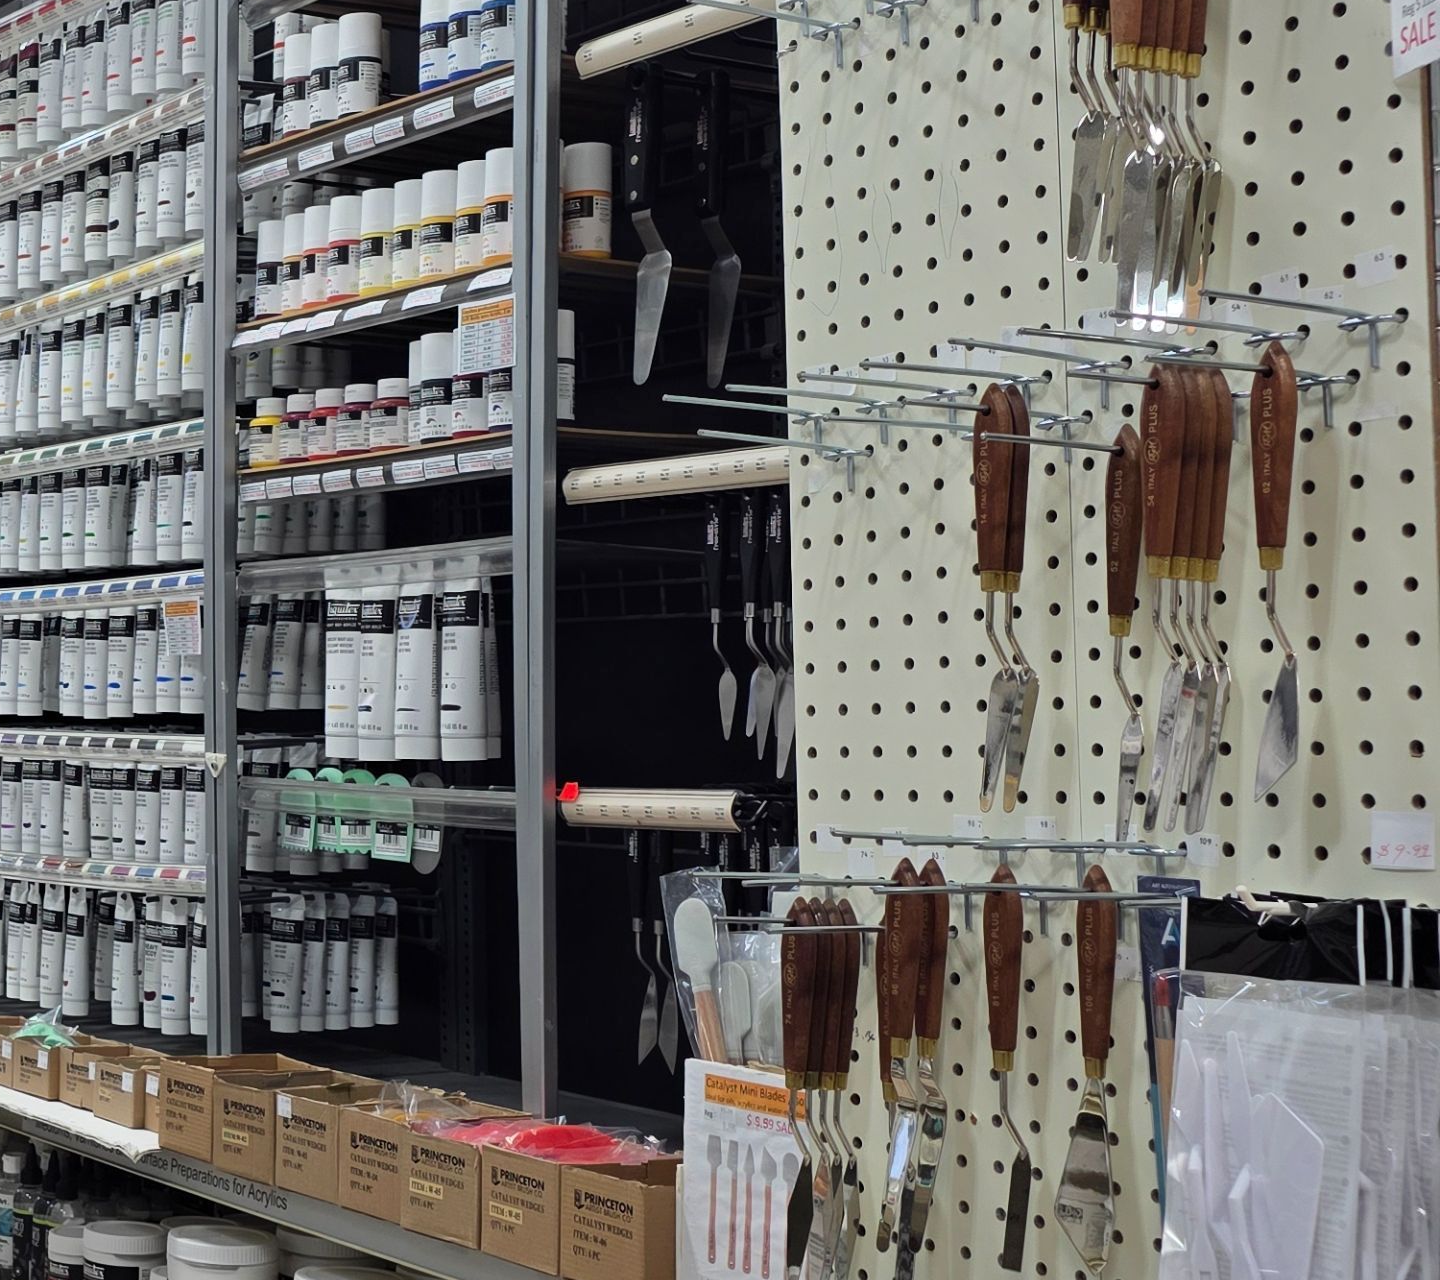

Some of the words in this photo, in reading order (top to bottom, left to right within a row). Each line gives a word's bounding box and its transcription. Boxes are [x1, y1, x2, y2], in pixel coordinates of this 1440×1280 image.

[1399, 10, 1437, 55] SALE
[1262, 387, 1273, 417] PLUS
[1148, 404, 1158, 434] PLUS
[980, 434, 988, 456] PL
[1115, 470, 1123, 499] PLUS
[892, 900, 902, 928] PLUS
[990, 911, 1000, 939] PLUS
[1085, 907, 1093, 936] PLUS
[787, 935, 796, 961] PLUS
[173, 1079, 205, 1095] PRINCETON
[705, 1077, 737, 1094] Catalyst
[740, 1083, 759, 1097] Mini
[759, 1087, 787, 1103] Blades
[230, 1100, 265, 1116] PRINCETON
[291, 1114, 326, 1132] PRINCETON
[359, 1133, 398, 1153] PRINCETON
[420, 1147, 465, 1169] PRINCETON
[170, 1160, 231, 1190] Preparations
[232, 1180, 246, 1195] for
[247, 1183, 288, 1211] Acrylics
[500, 1169, 544, 1191] PRINCETON
[584, 1191, 633, 1216] PRINCETON
[574, 1214, 606, 1233] CATALYST
[608, 1223, 633, 1240] WEDGES
